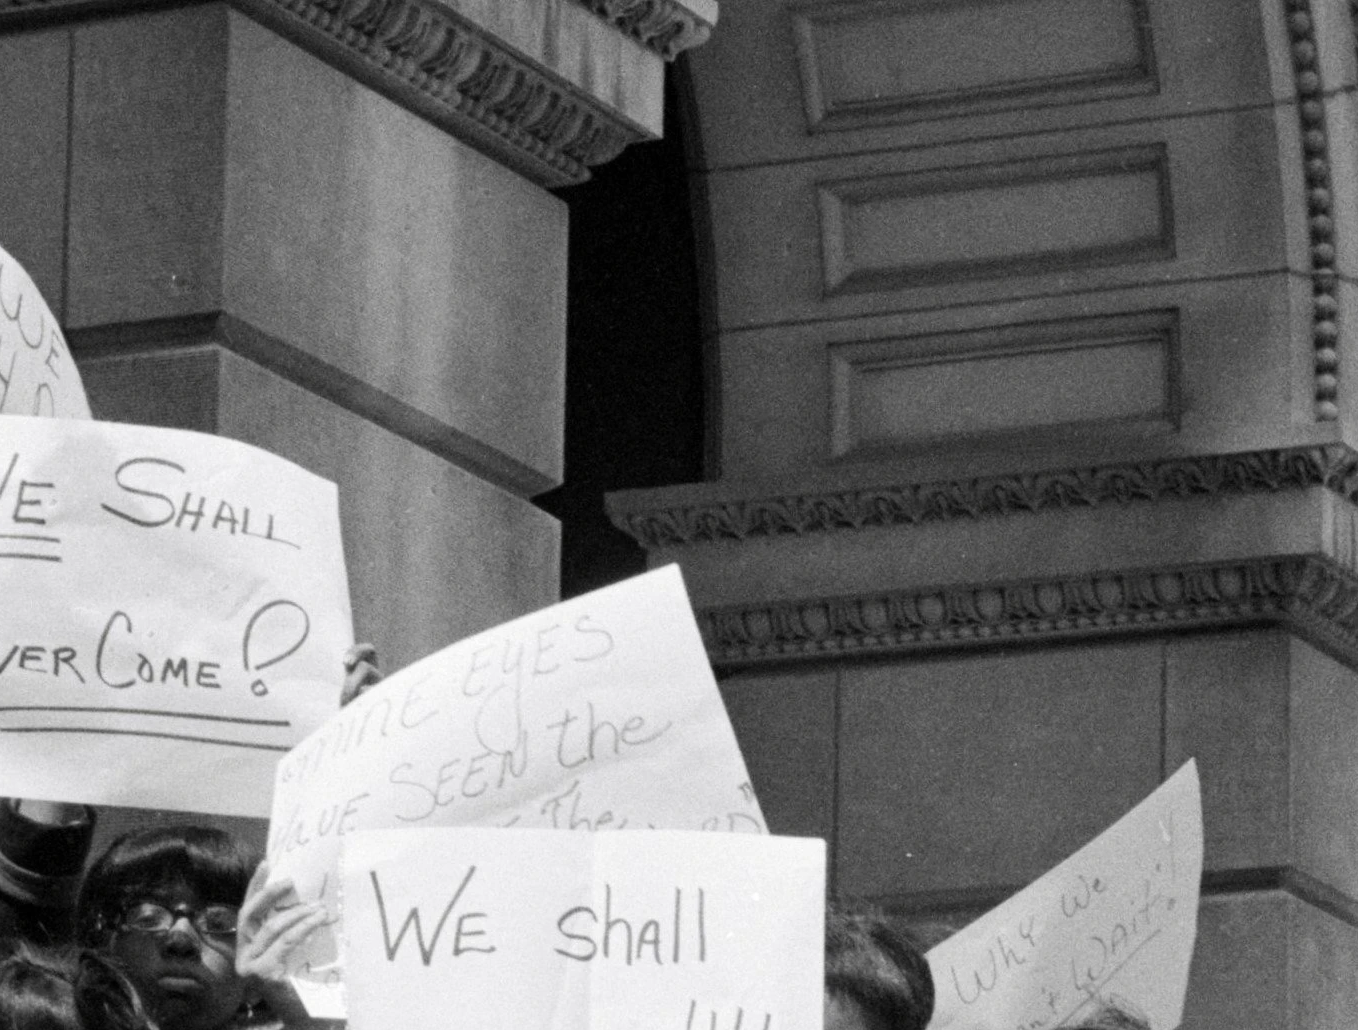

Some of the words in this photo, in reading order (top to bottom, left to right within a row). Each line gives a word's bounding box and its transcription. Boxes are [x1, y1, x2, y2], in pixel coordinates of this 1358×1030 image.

[101, 457, 301, 549] SHALL
[389, 744, 528, 822] SEEN
[370, 864, 497, 966] WE
